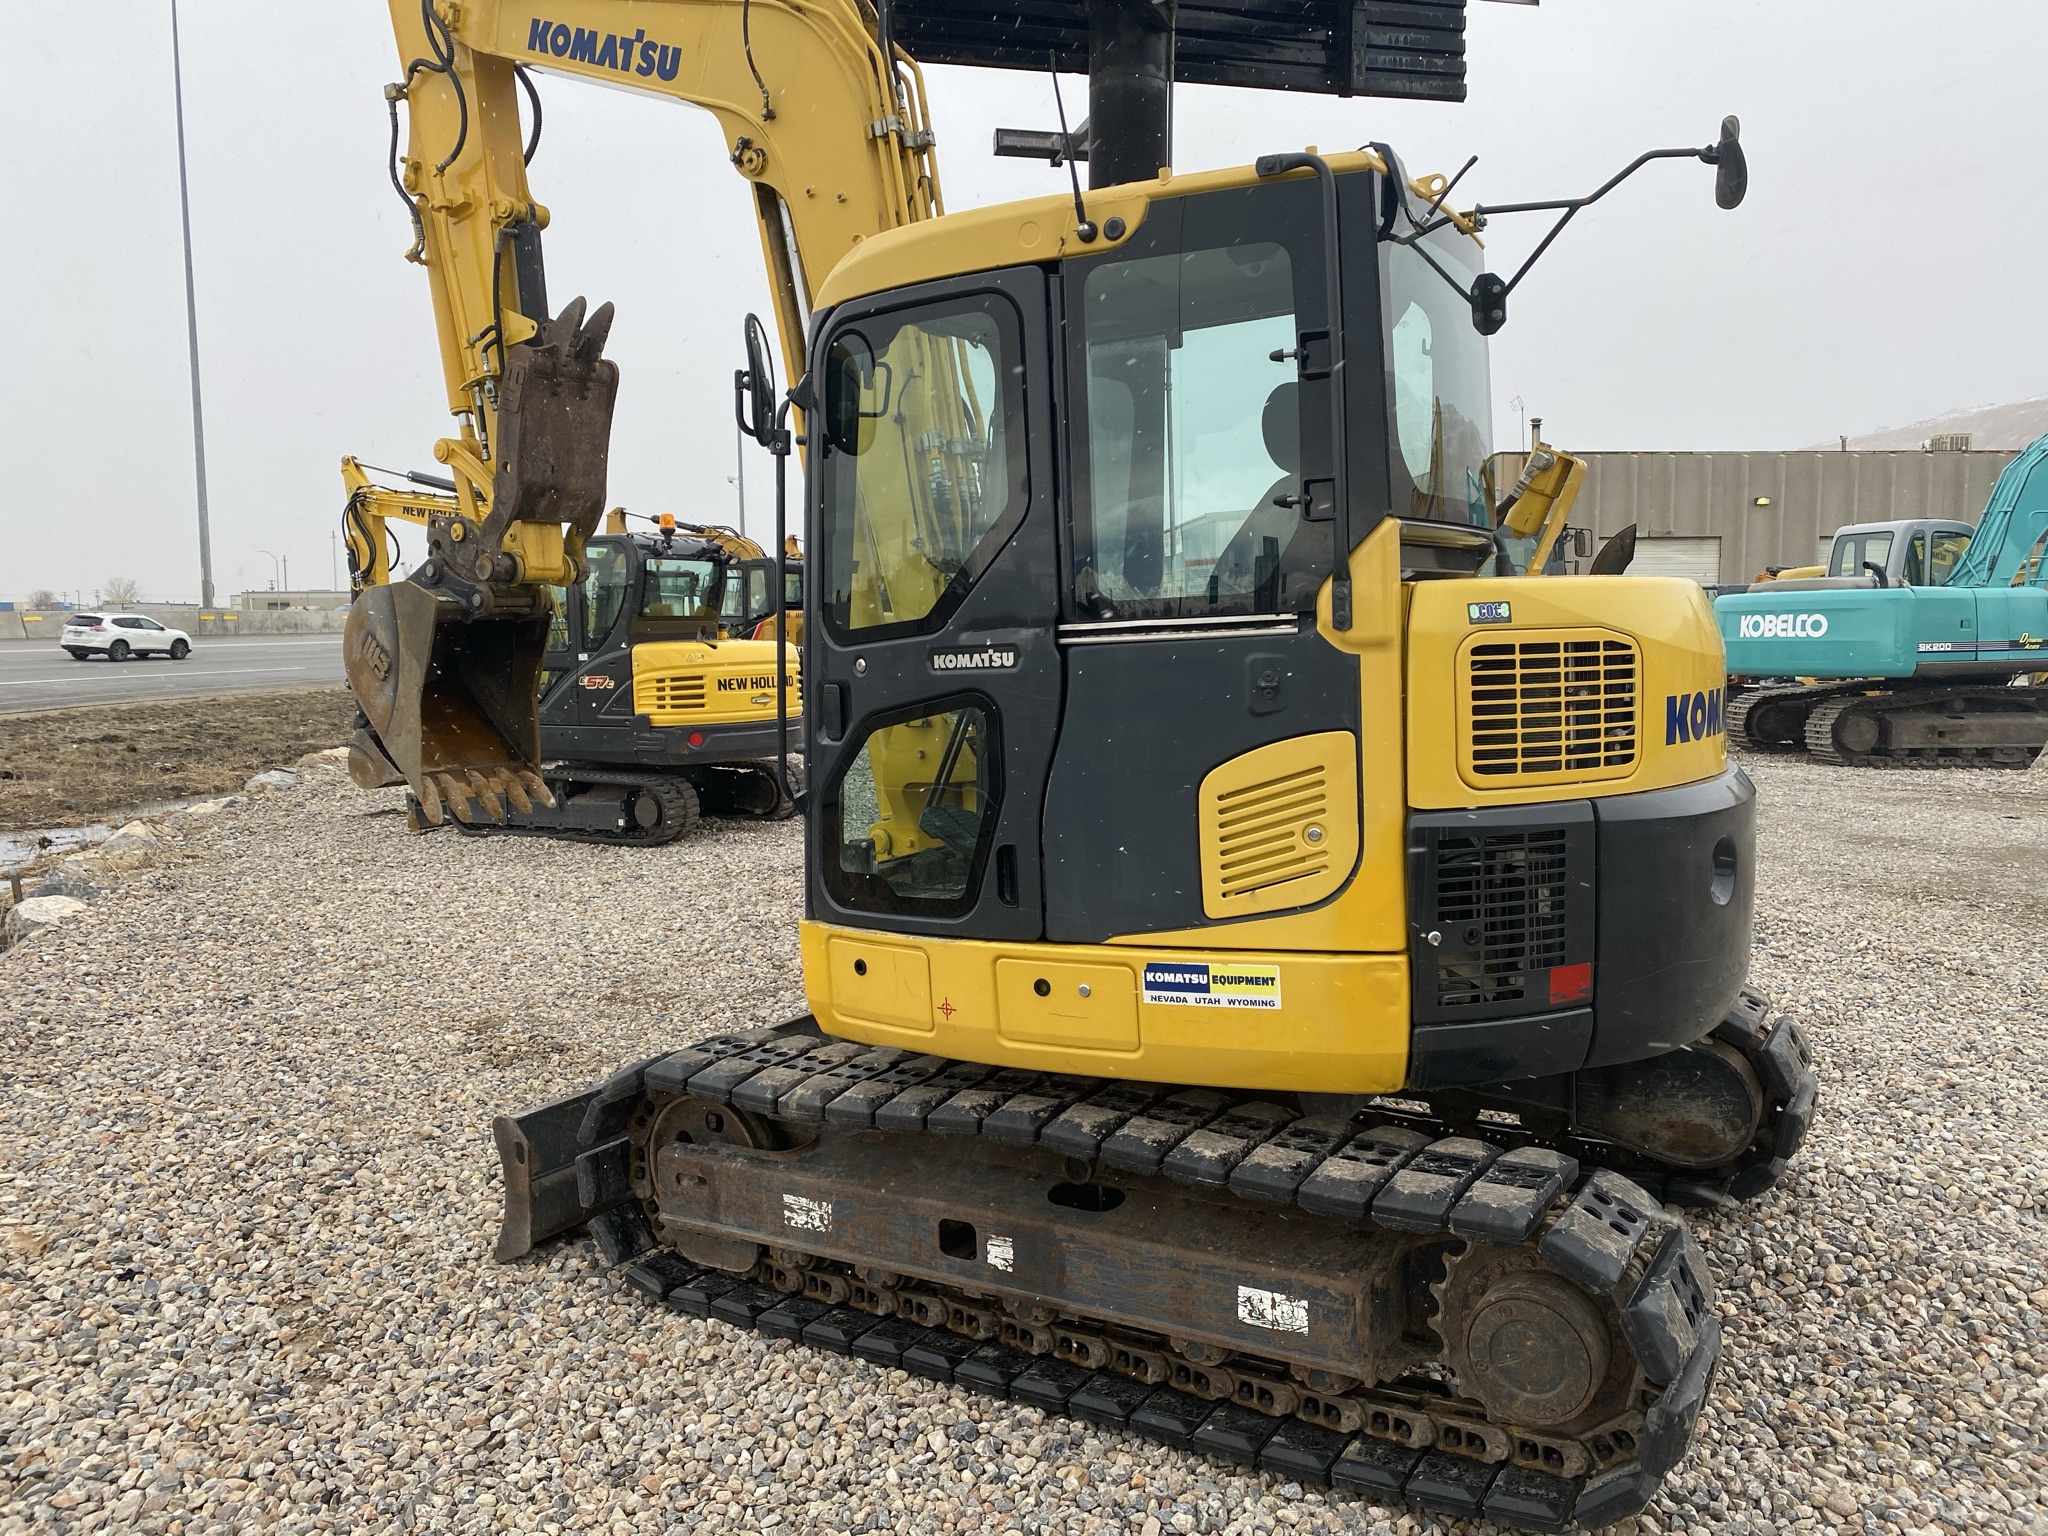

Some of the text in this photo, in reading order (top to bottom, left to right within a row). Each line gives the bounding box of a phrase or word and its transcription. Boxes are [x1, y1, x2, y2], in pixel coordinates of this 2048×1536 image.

[528, 18, 682, 81] KOMATSU
[402, 506, 426, 518] NEW
[1740, 614, 1828, 638] KOBELCO
[1919, 643, 1951, 652] SK200
[933, 648, 1015, 669] KOMATSU
[717, 675, 794, 692] NEW HOLLND
[1145, 971, 1276, 987] KOMATSU EQUIPMENT
[1150, 994, 1276, 1008] NEVADA UTAH WYOMING
